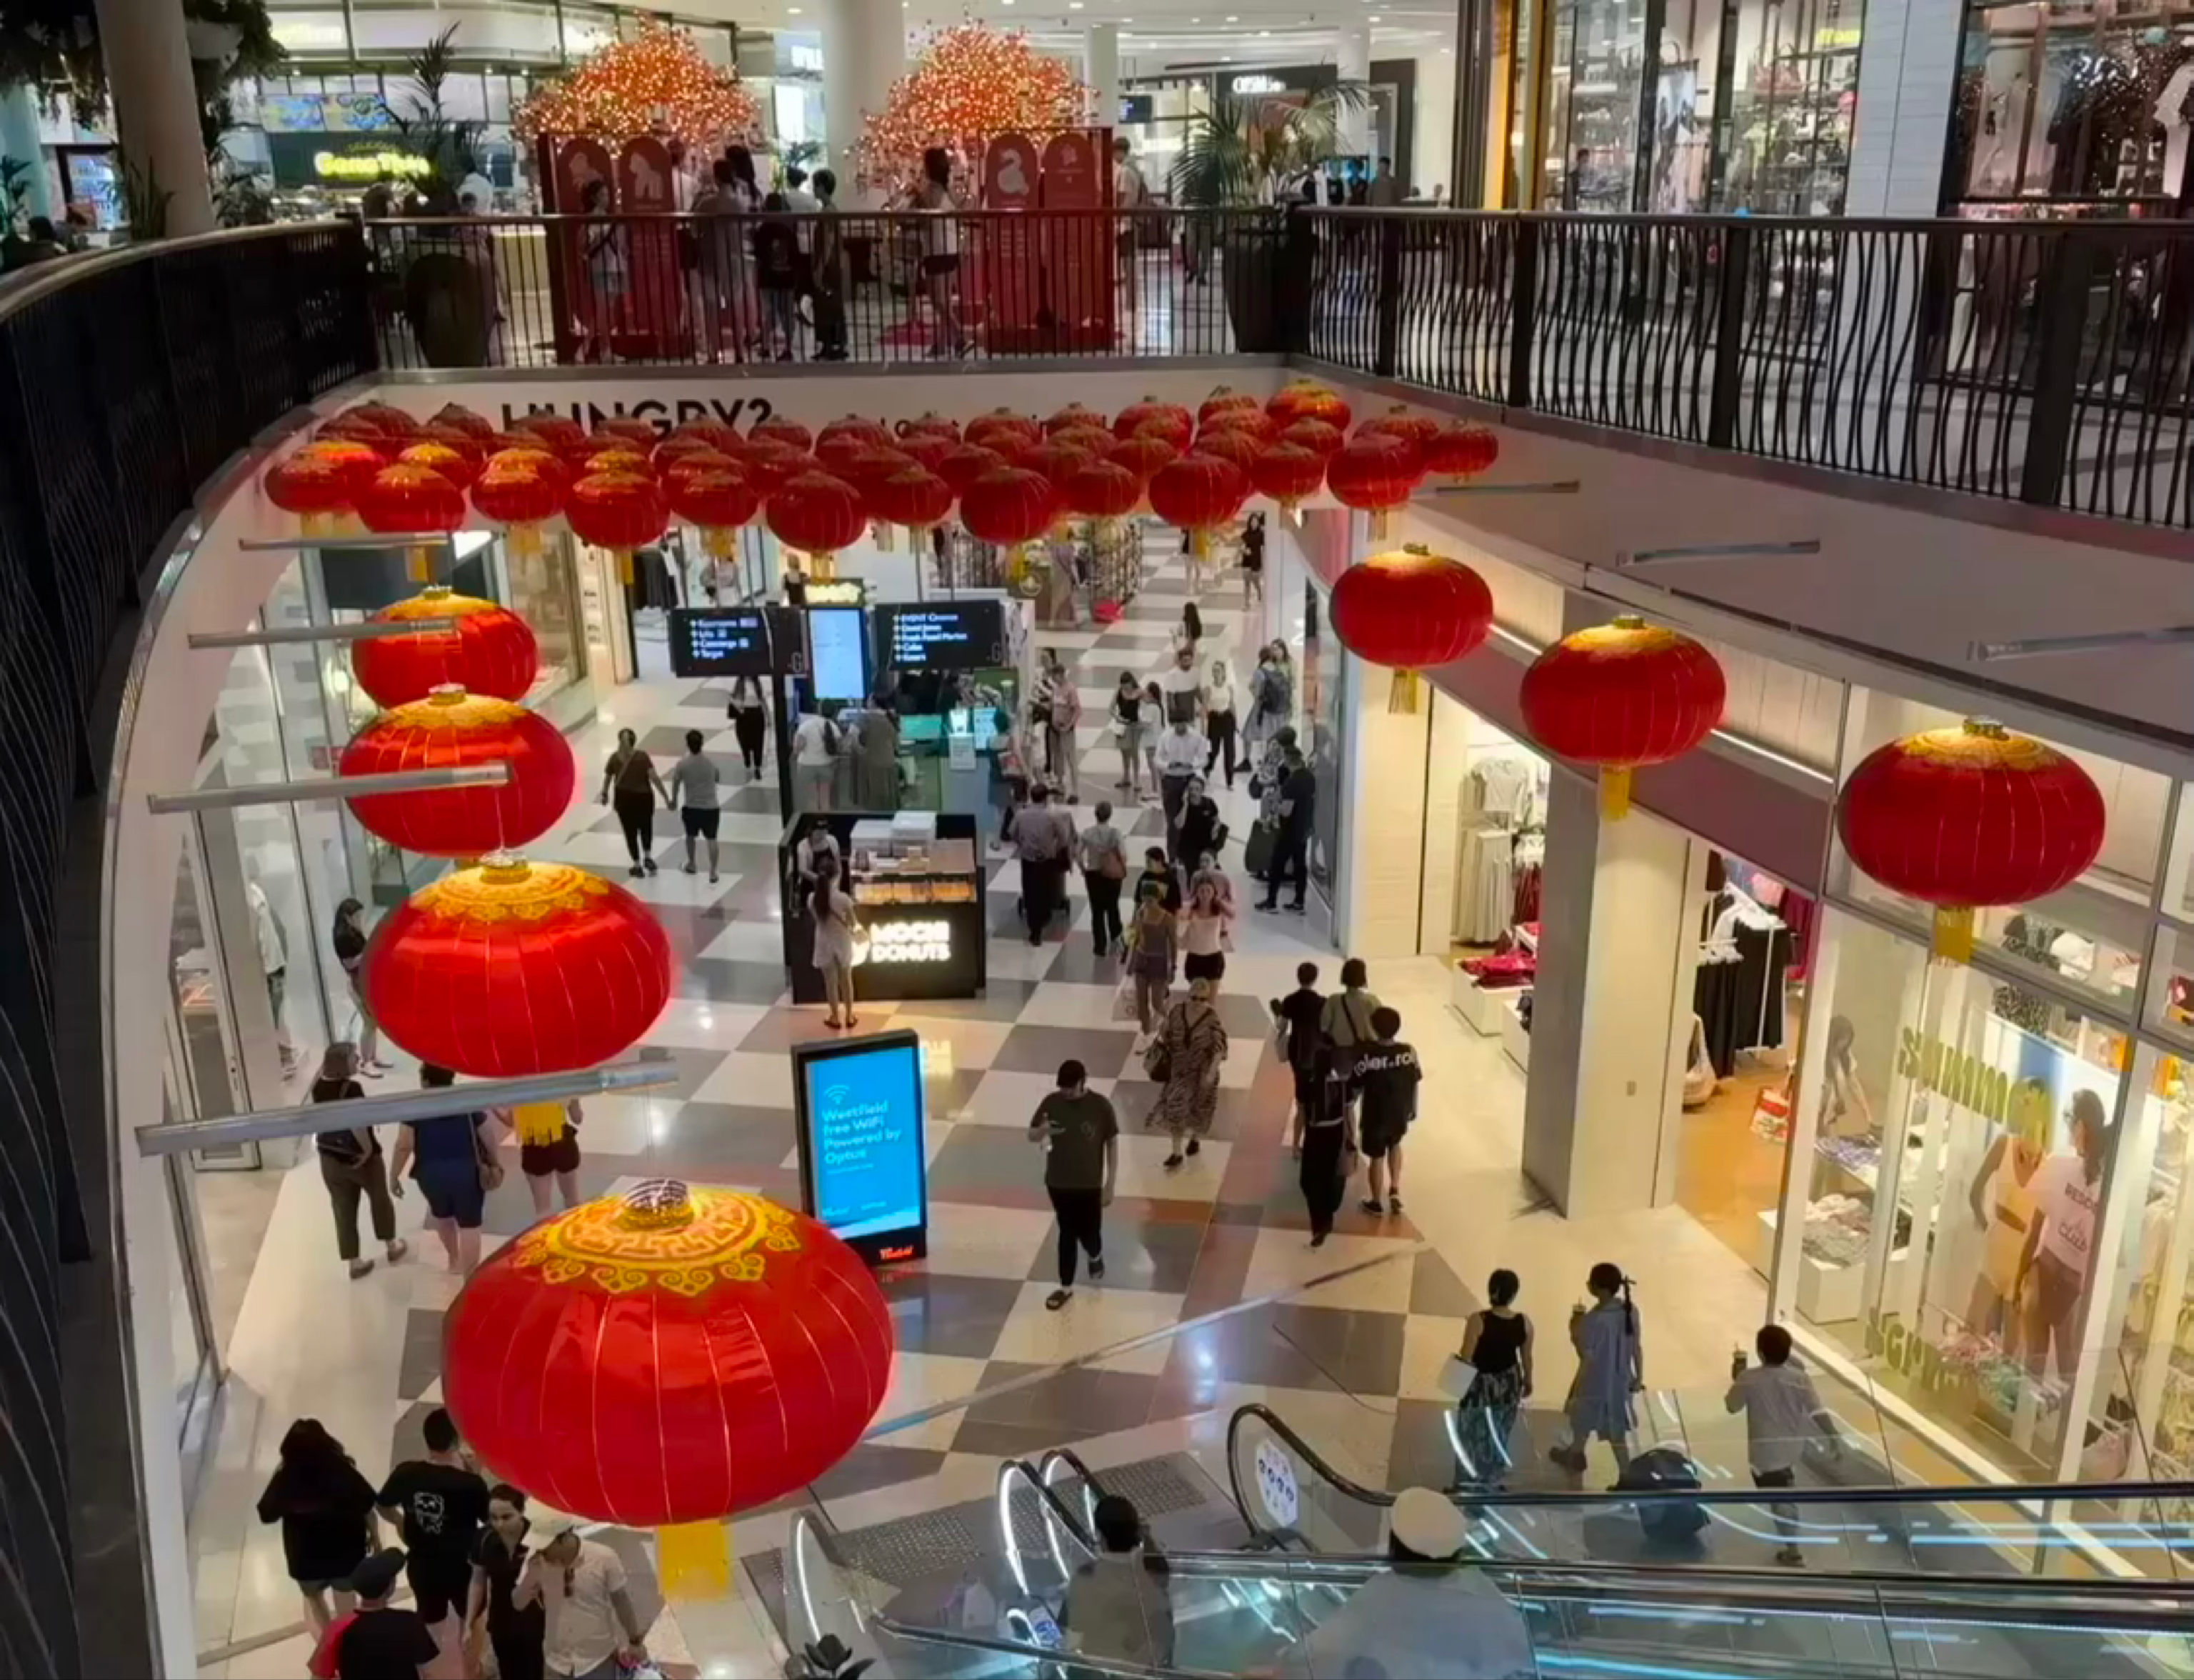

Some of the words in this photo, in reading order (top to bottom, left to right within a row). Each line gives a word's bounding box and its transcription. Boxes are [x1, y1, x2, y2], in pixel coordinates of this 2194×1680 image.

[871, 943, 952, 963] DONUTS
[821, 1099, 888, 1121] Westfield
[823, 1130, 883, 1150] Powered
[884, 1128, 902, 1141] by
